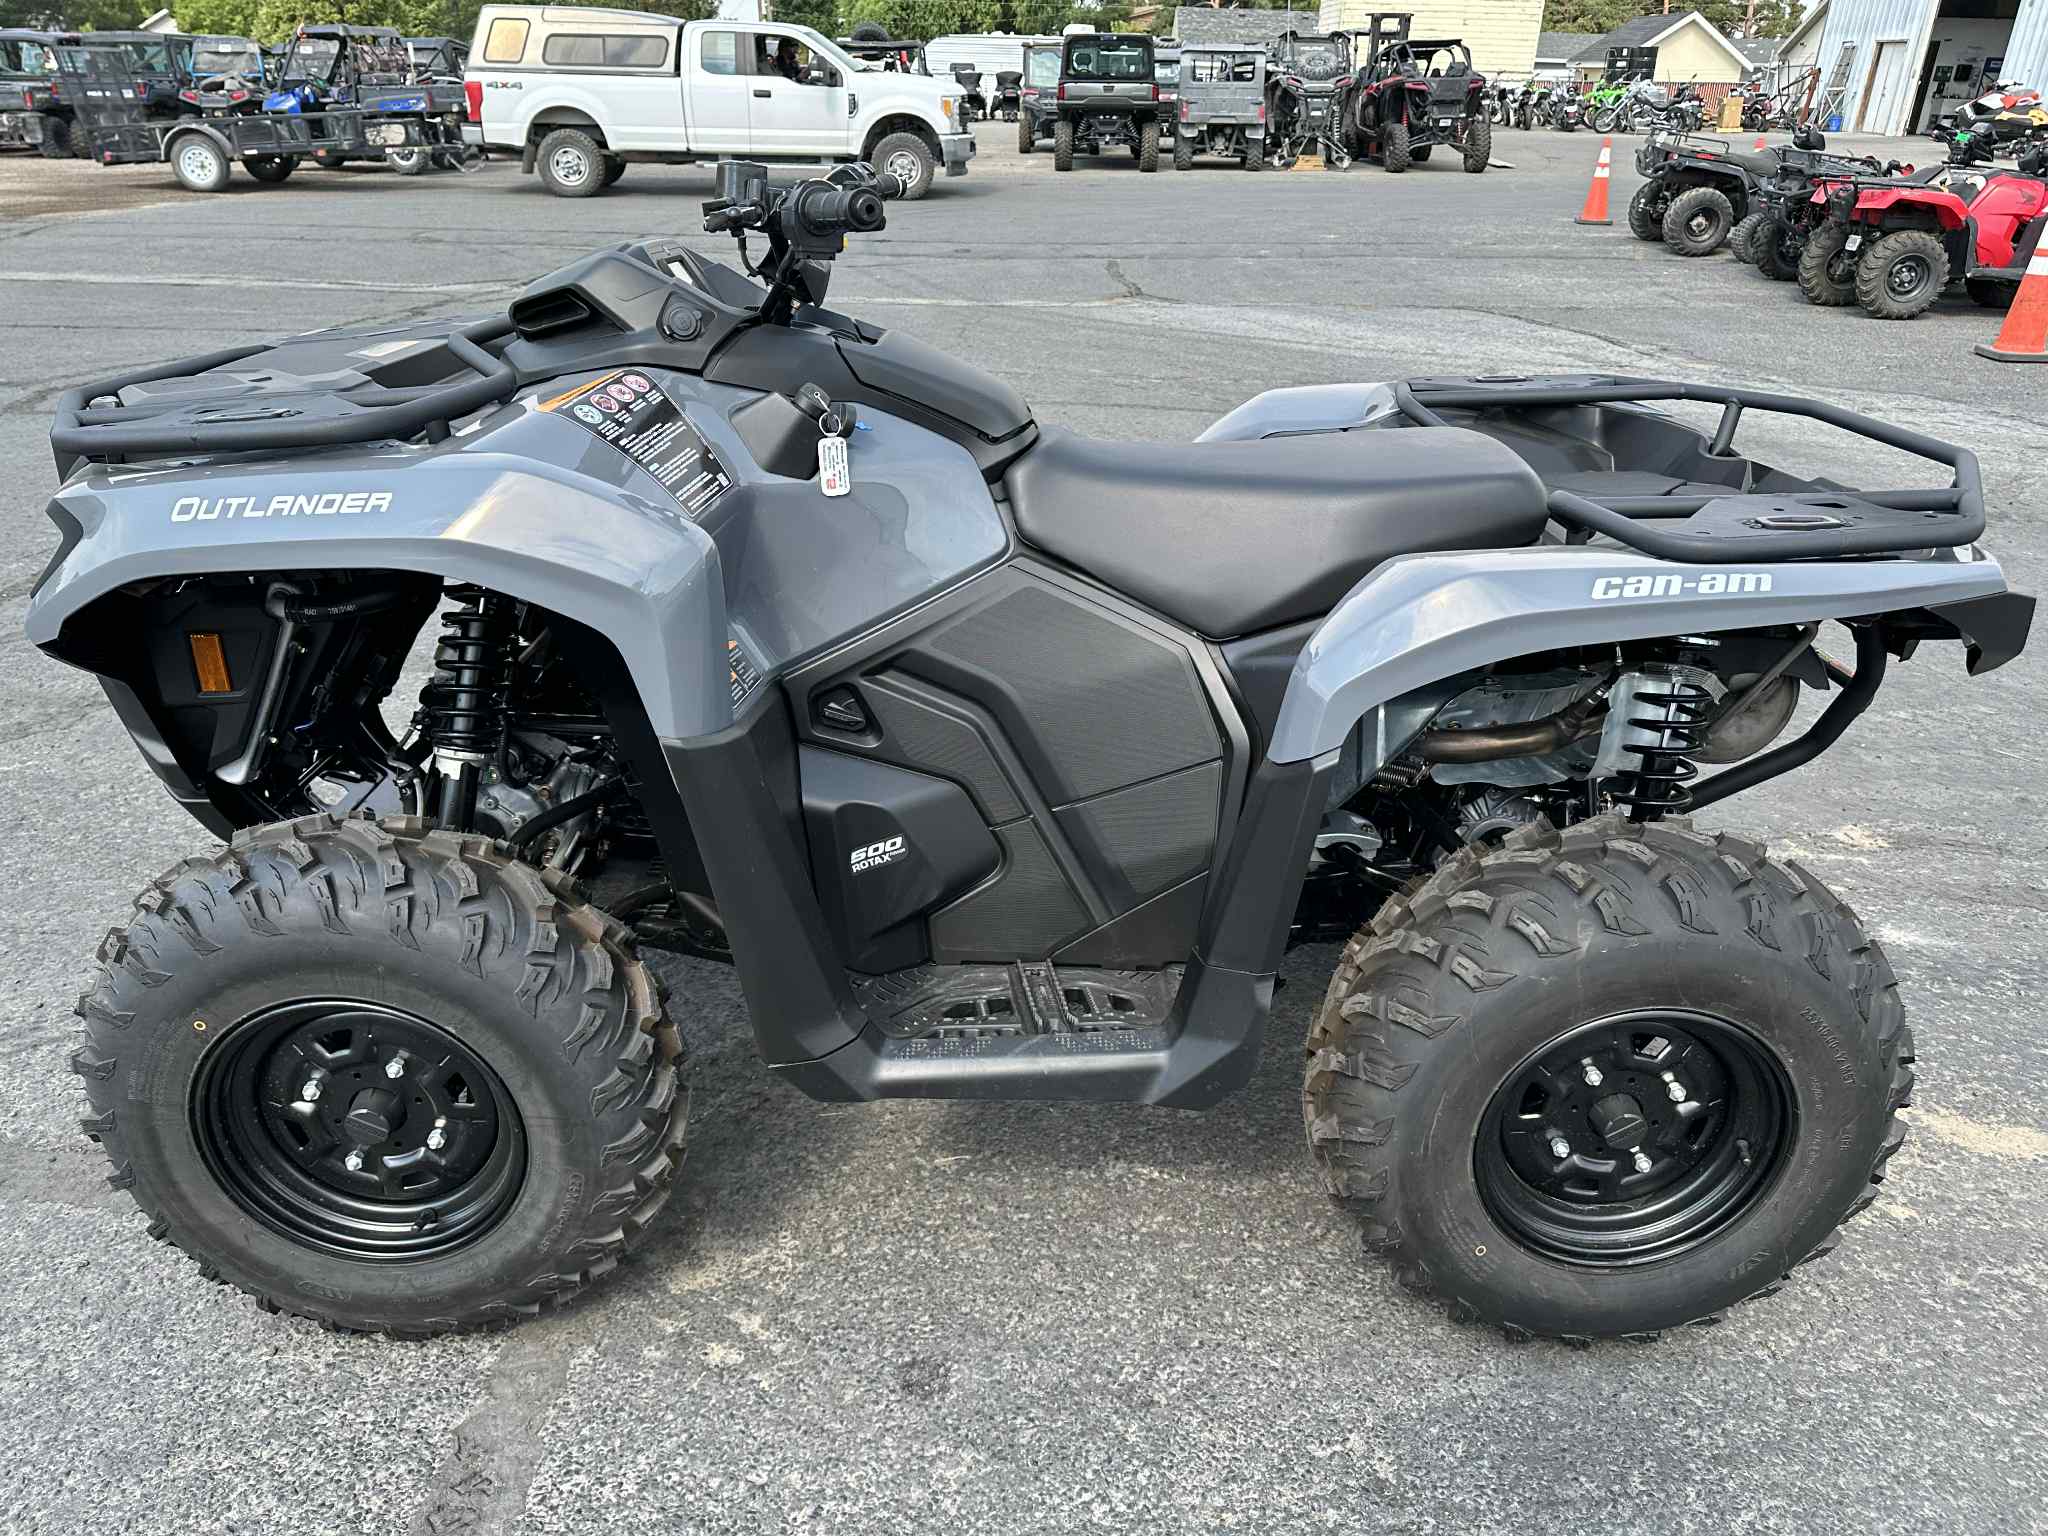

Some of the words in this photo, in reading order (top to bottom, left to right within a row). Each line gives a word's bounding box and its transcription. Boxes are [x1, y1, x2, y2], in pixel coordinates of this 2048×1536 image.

[171, 492, 392, 522] OUTLANDER
[1591, 573, 1773, 600] can-am
[851, 852, 892, 873] ROTAX
